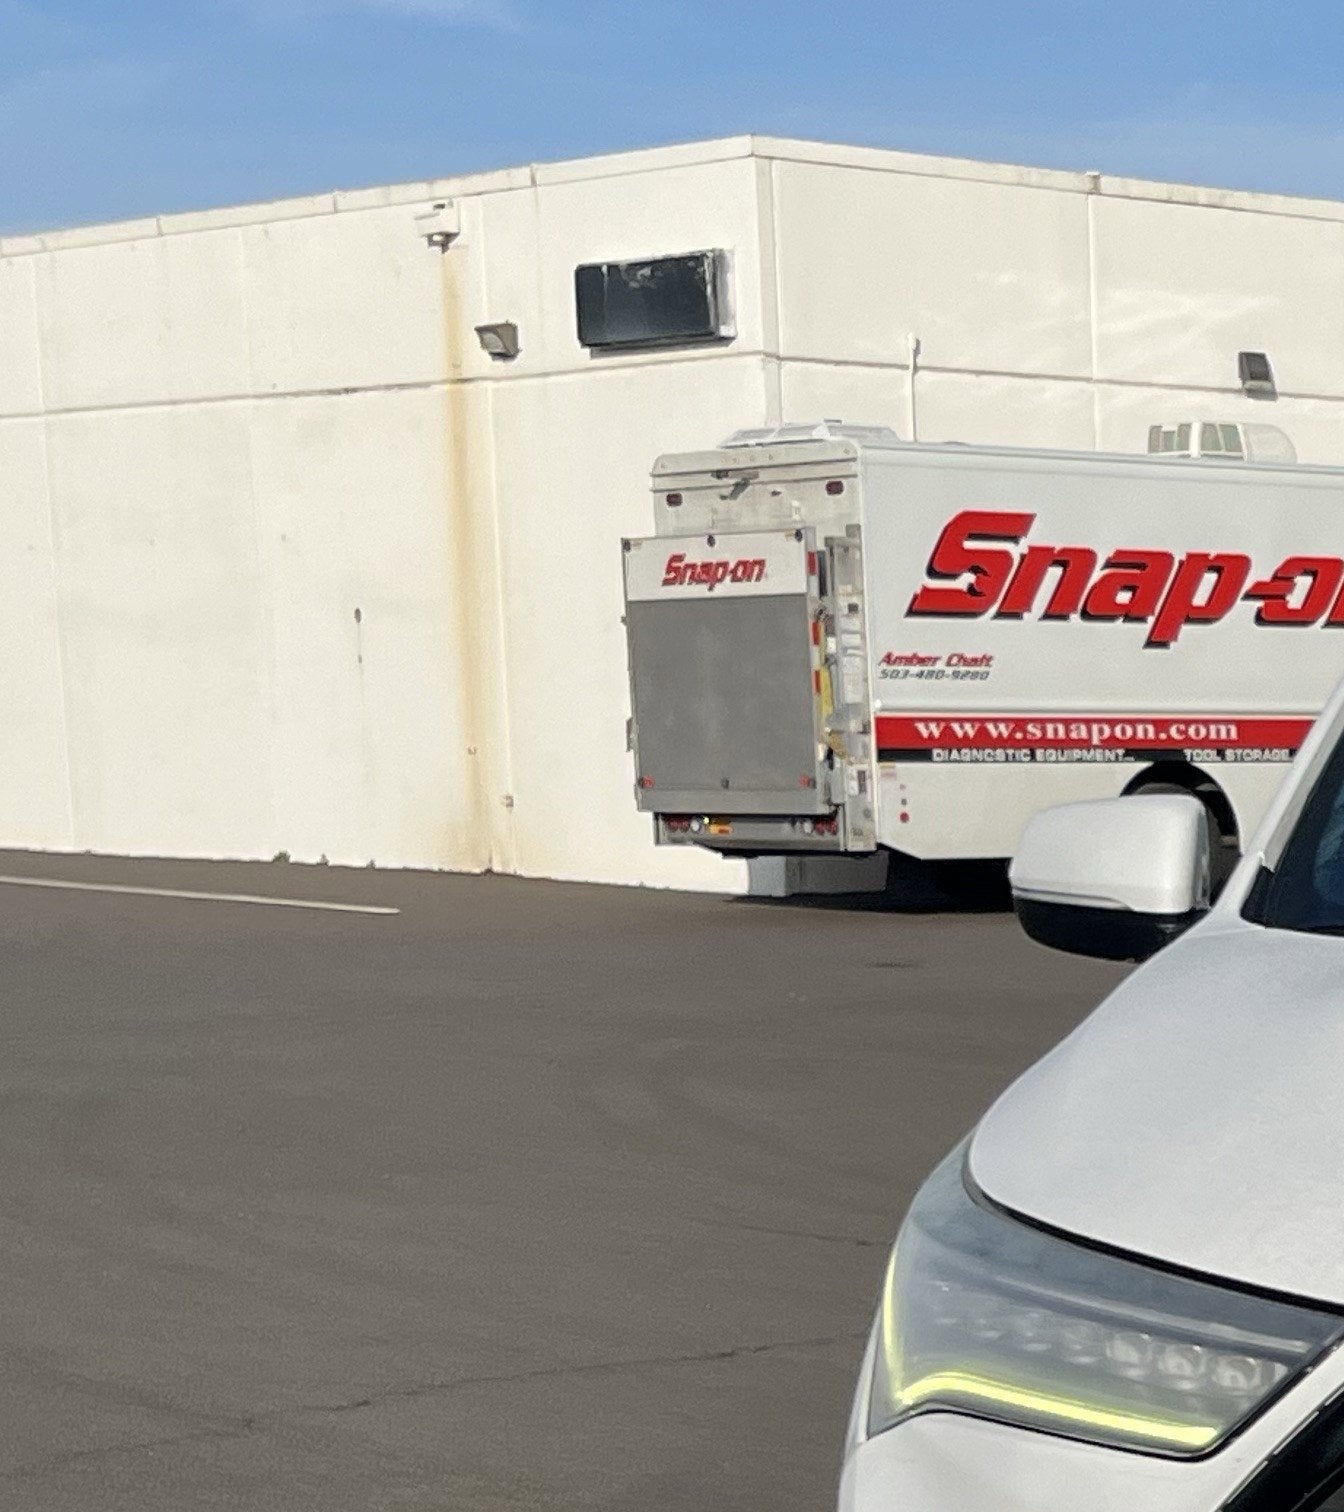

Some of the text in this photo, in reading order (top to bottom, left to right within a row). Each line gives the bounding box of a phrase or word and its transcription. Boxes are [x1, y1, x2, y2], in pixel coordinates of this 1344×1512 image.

[661, 553, 766, 591] Snap-on
[914, 720, 1240, 746] www.snapon.com
[931, 748, 1031, 763] DIAGNOSTIC
[1184, 749, 1221, 763] TOOL
